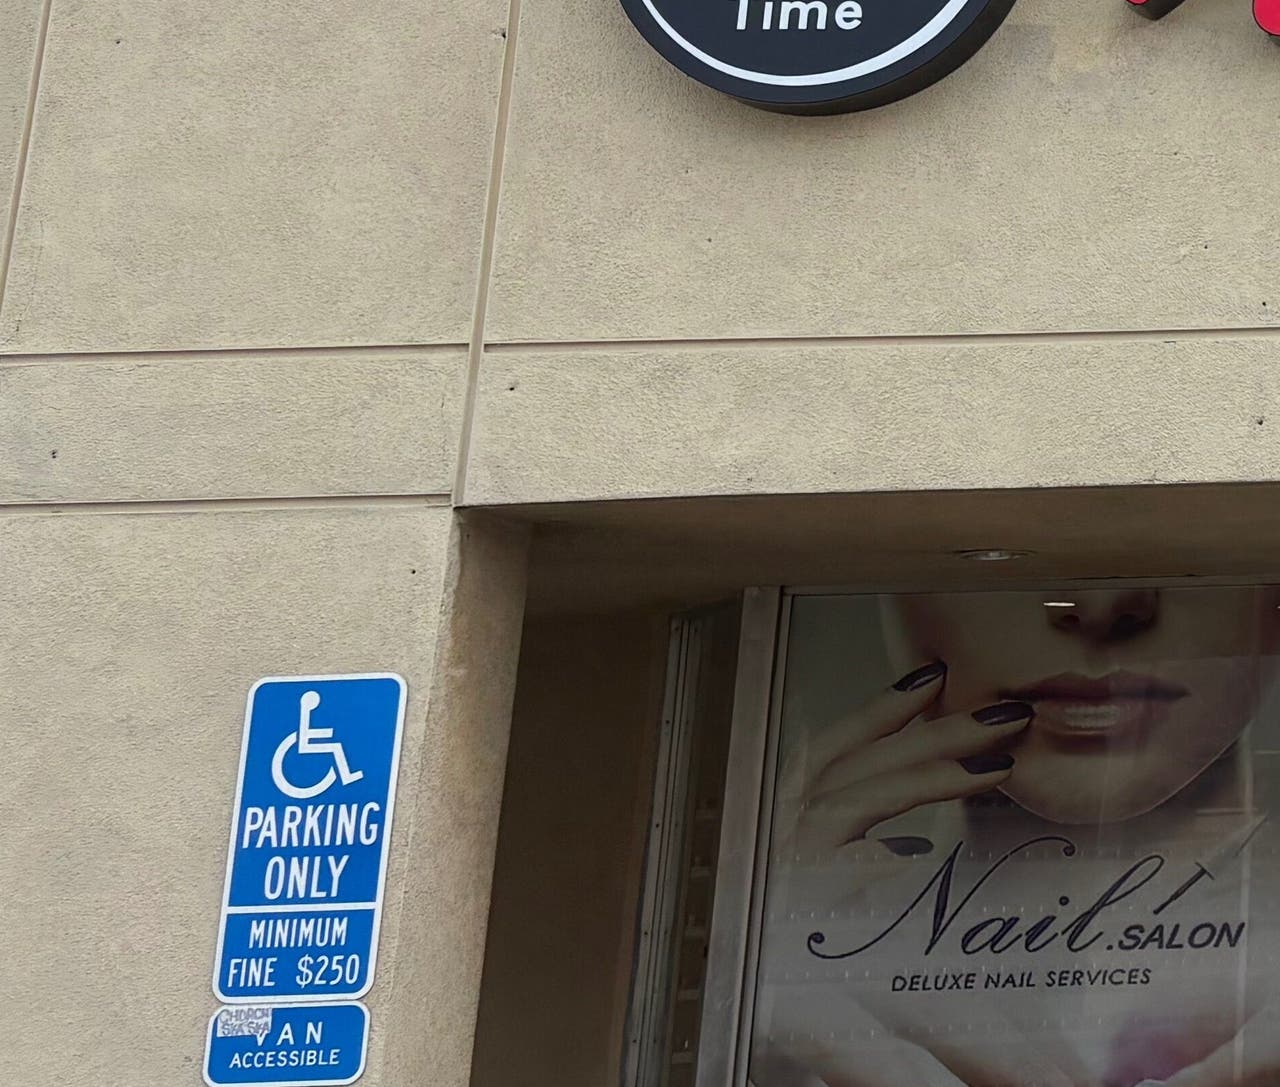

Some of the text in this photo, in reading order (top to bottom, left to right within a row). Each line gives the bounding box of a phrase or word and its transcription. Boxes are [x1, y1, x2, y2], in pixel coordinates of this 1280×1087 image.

[242, 801, 381, 849] PARKING
[264, 854, 350, 900] ONLY
[248, 917, 347, 949] MINIMUM
[227, 954, 360, 989] FINE $250
[891, 967, 1152, 992] DELUXE NAIL SERVICES
[229, 1049, 340, 1070] ACCESSIBLE
